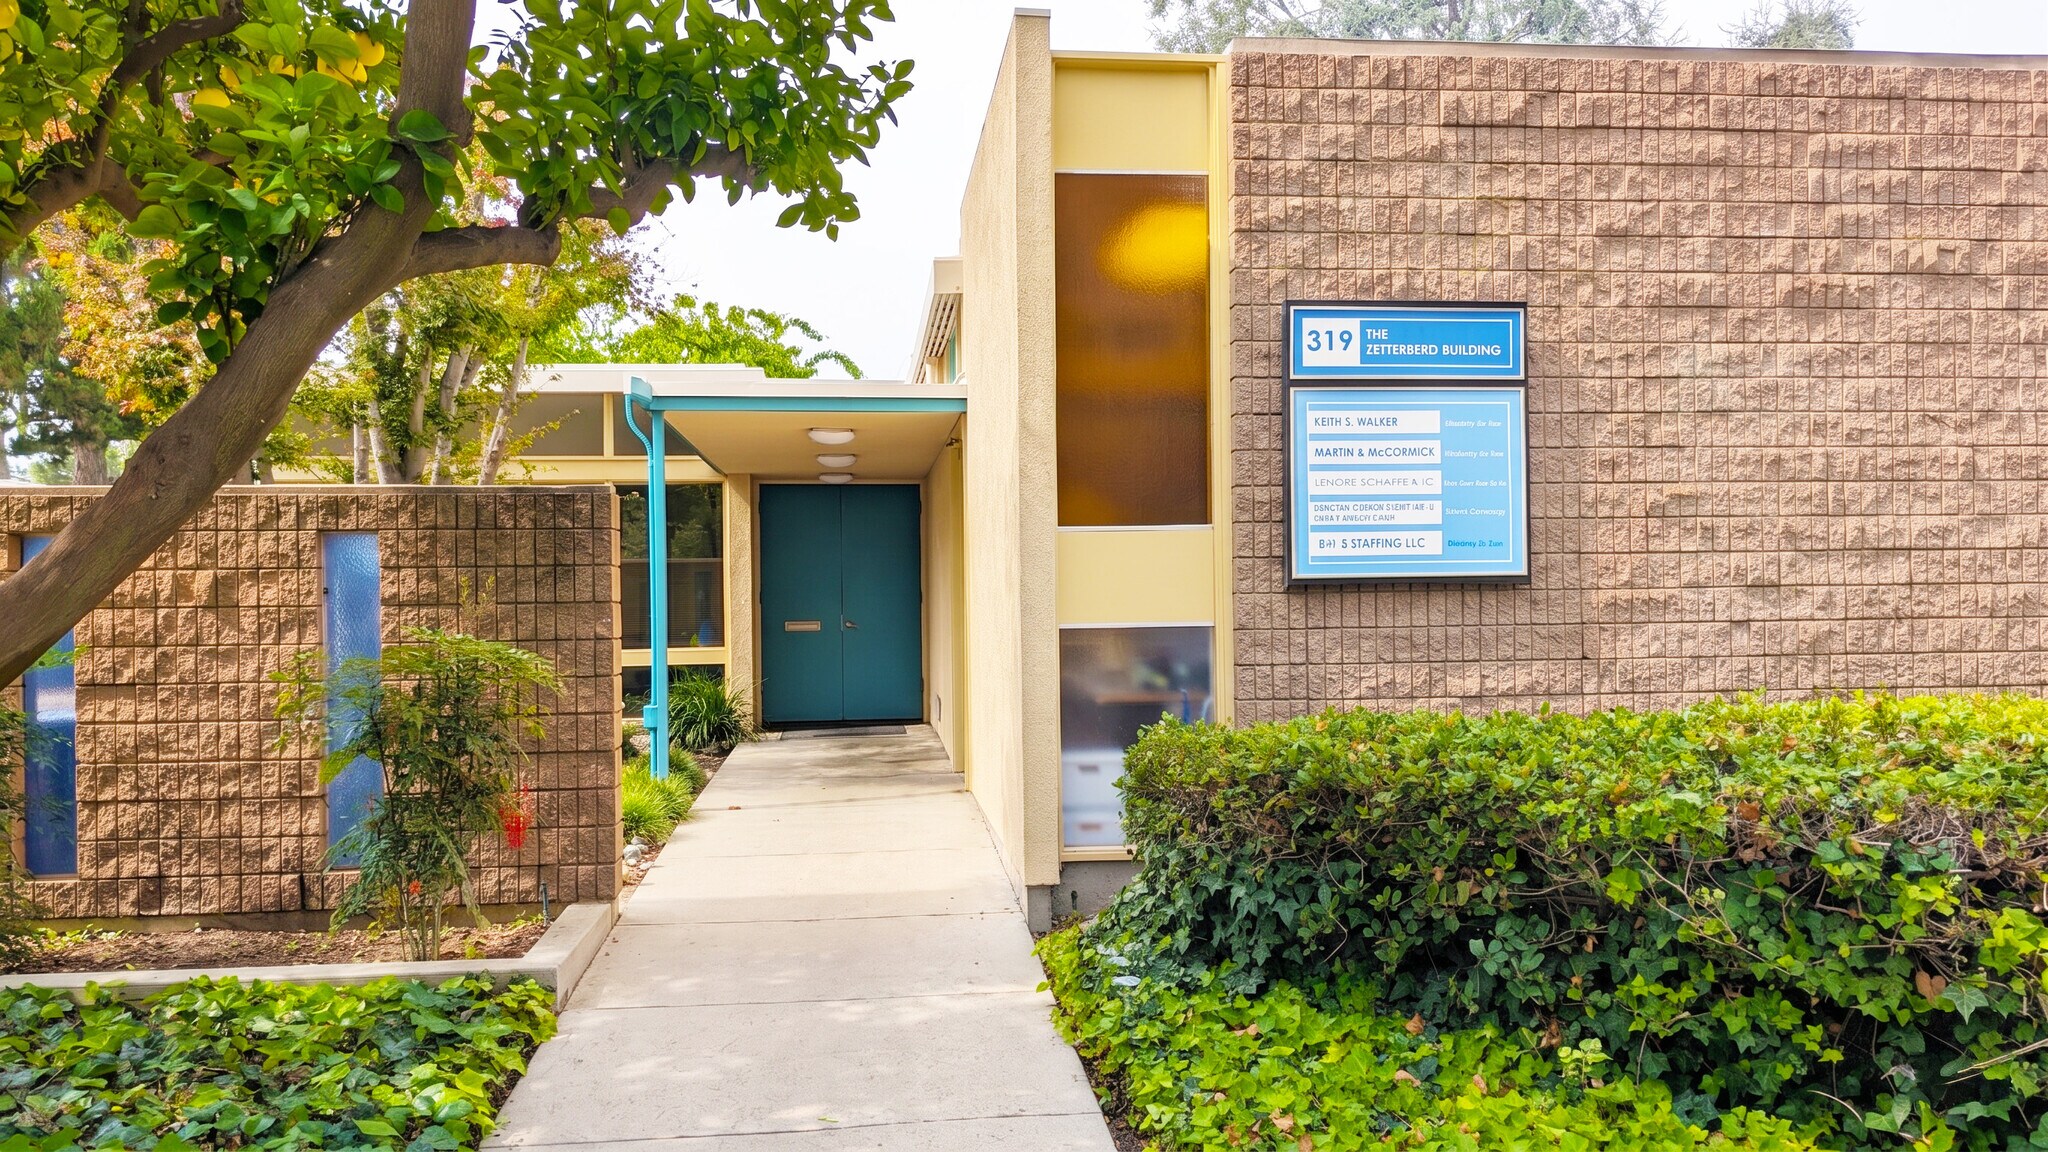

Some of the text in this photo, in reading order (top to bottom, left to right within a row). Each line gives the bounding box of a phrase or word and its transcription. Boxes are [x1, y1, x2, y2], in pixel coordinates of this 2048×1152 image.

[1366, 329, 1389, 340] THE
[1306, 329, 1353, 352] 319
[1366, 344, 1502, 356] ZETTERBERD BUILDING
[1314, 417, 1398, 427] KEITH S. WALKER
[1314, 447, 1354, 457] MARTIN
[1357, 447, 1365, 457] &
[1367, 447, 1435, 457] McCORMICK
[1314, 478, 1357, 487] LENORE
[1351, 538, 1402, 549] STAFFING
[1405, 538, 1426, 548] LLC
